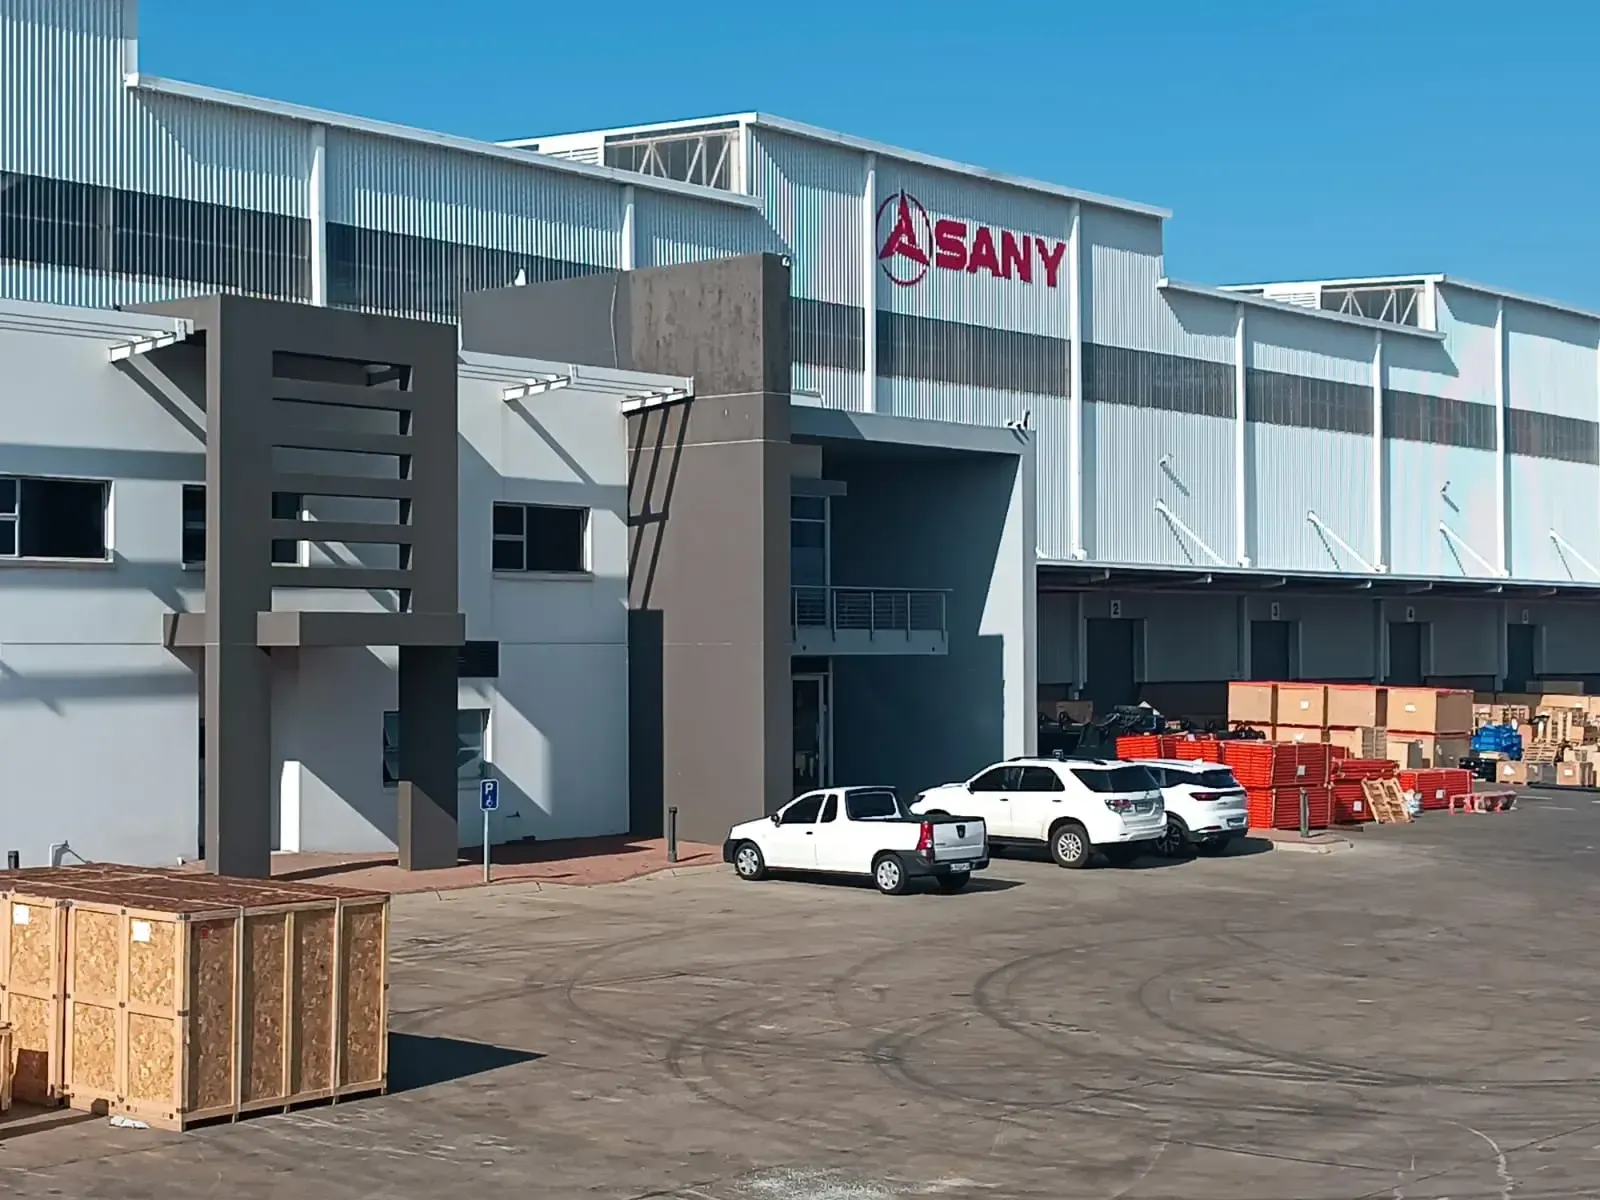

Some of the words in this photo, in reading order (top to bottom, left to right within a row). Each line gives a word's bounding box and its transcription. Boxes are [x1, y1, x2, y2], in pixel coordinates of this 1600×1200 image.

[935, 219, 1066, 287] SANY
[1113, 602, 1119, 615] 2
[485, 783, 494, 795] P
